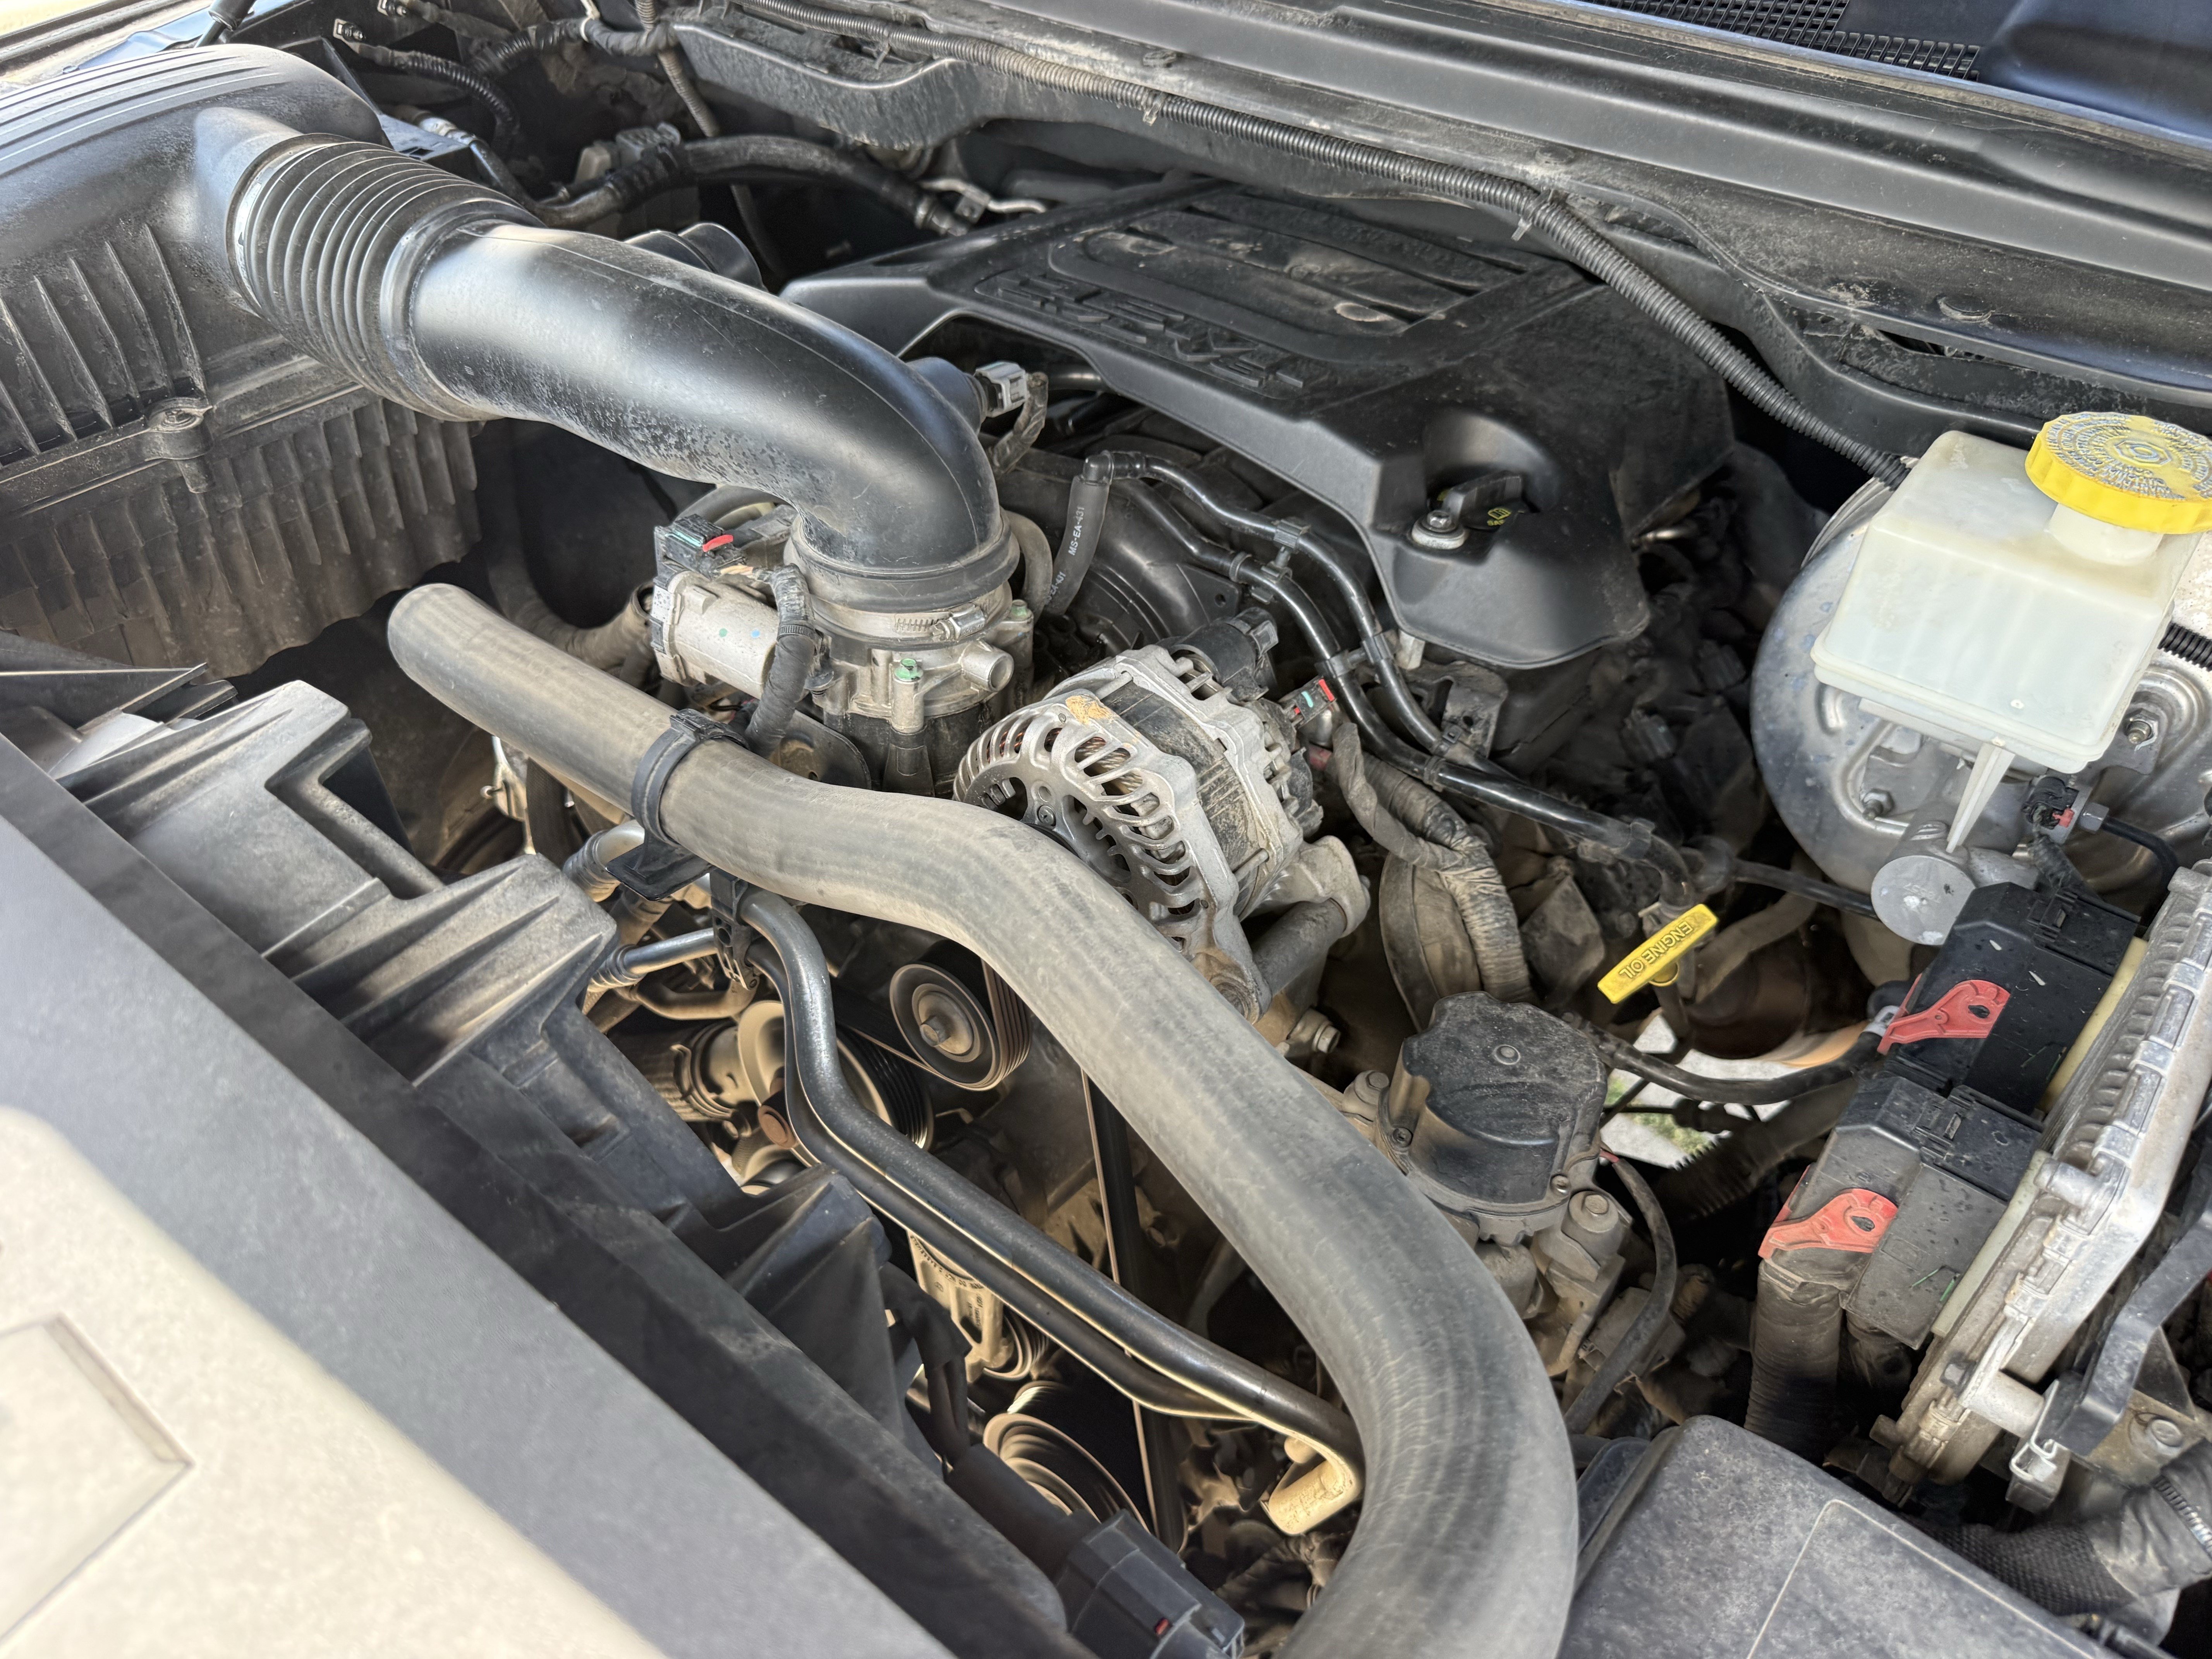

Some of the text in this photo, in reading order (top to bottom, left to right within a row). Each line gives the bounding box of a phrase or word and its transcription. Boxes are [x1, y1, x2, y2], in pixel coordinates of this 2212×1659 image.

[1068, 507, 1085, 556] MS-EA-431
[1619, 921, 1694, 979] ENGINE OIL
